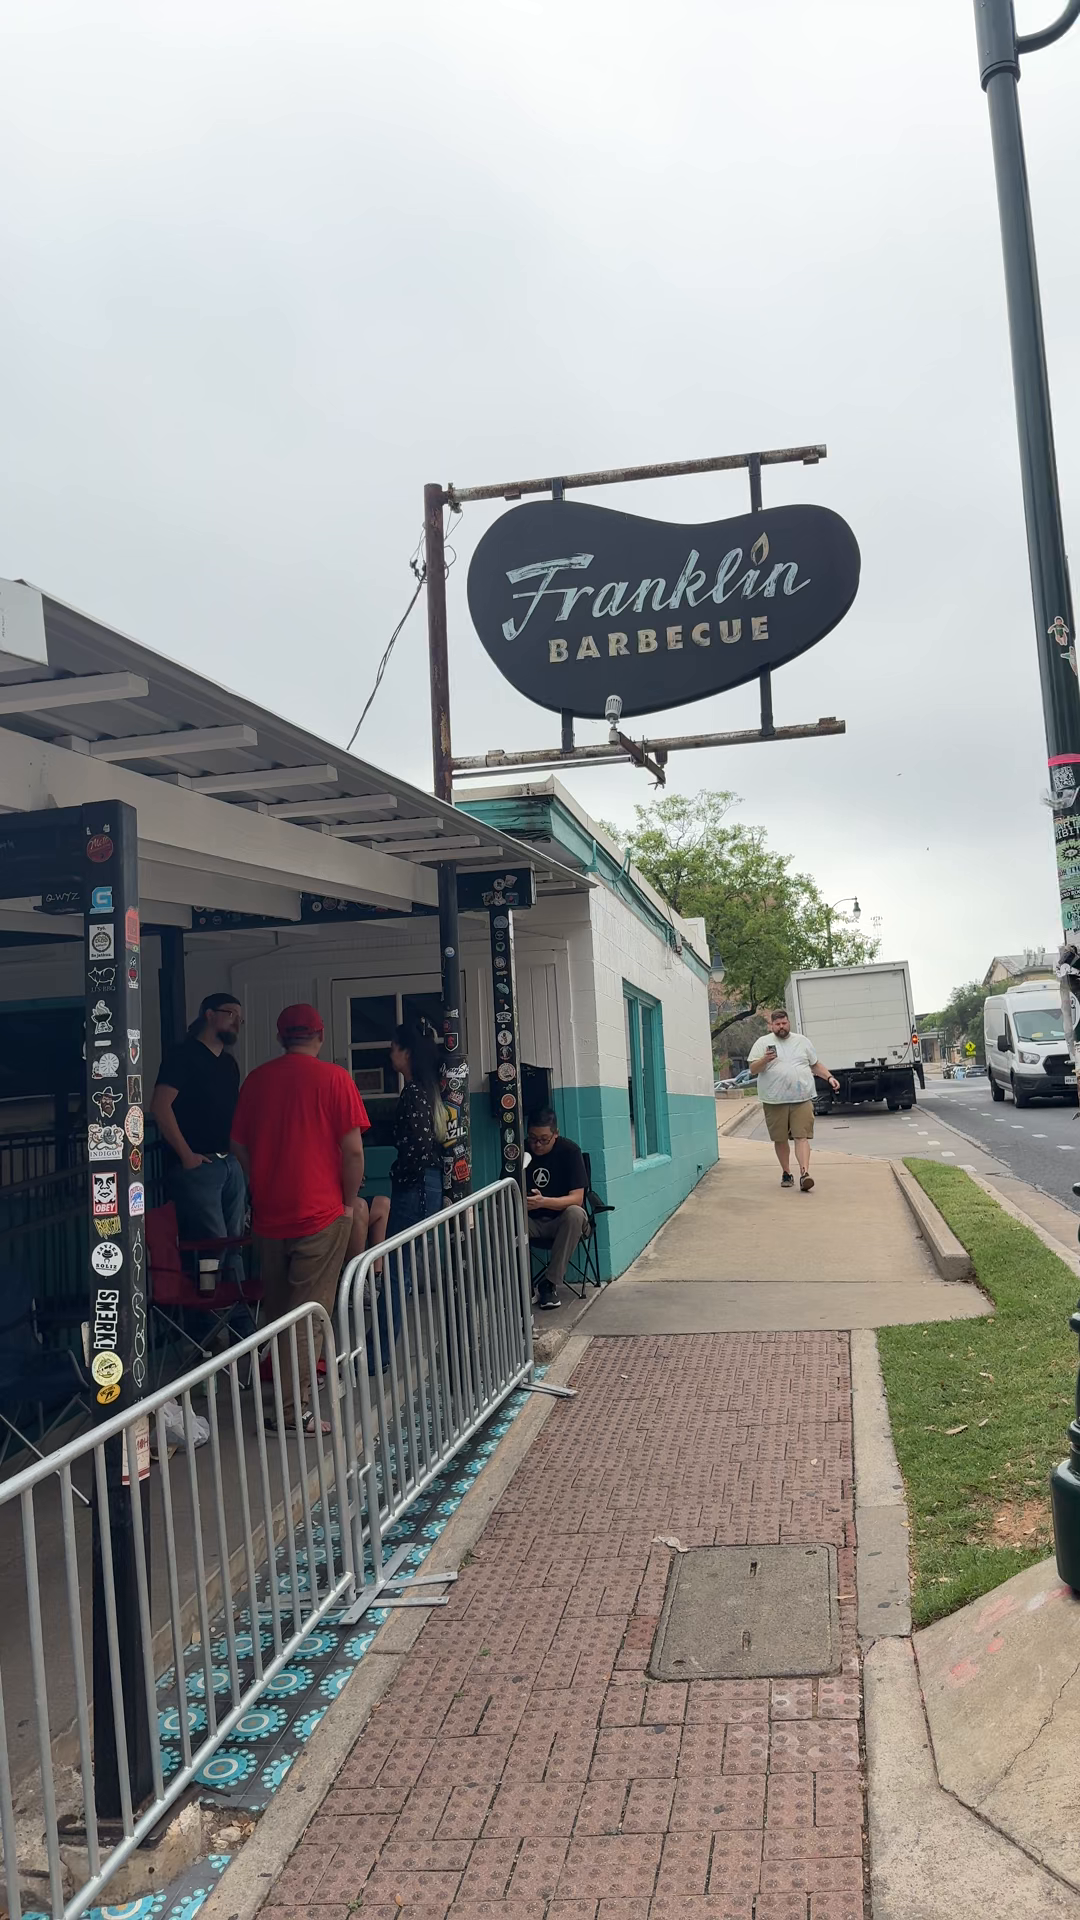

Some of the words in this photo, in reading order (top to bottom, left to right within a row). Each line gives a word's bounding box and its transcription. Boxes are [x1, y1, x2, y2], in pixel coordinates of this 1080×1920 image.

[501, 532, 811, 641] Franklin
[548, 615, 769, 663] BARBECUE
[96, 1203, 115, 1213] OBEY
